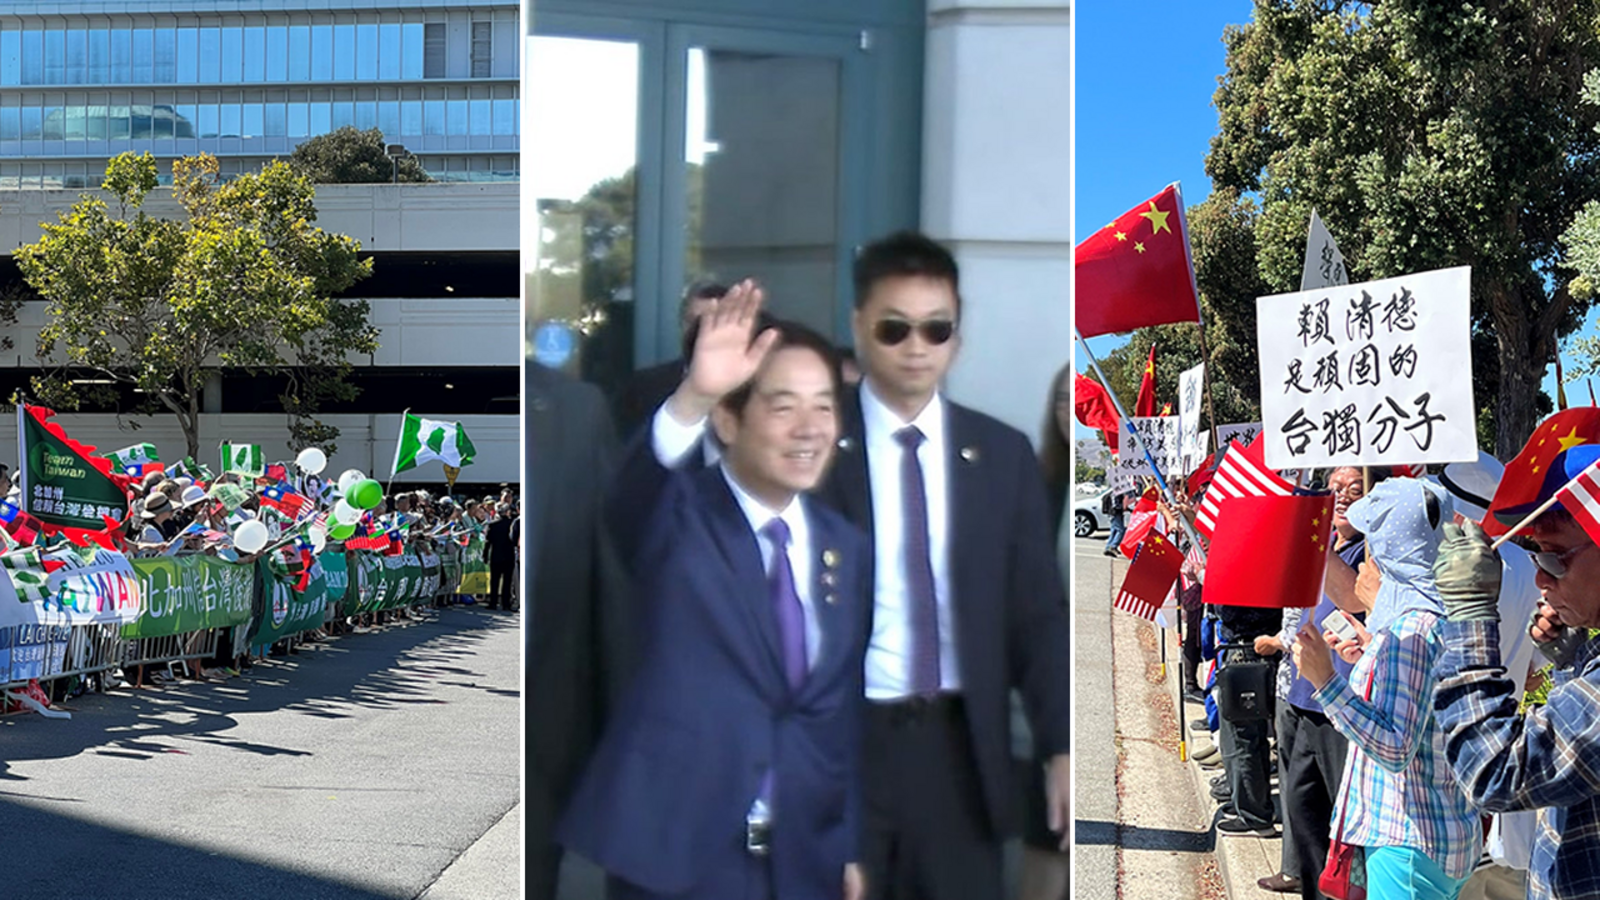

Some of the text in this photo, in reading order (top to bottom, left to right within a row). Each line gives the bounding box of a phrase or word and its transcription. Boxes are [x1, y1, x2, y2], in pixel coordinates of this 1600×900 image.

[1297, 286, 1418, 347] 賴清德
[1284, 343, 1418, 394] 是頑固的
[1281, 392, 1446, 457] 台獨分子
[43, 451, 75, 466] Team
[44, 463, 86, 479] Taiwan
